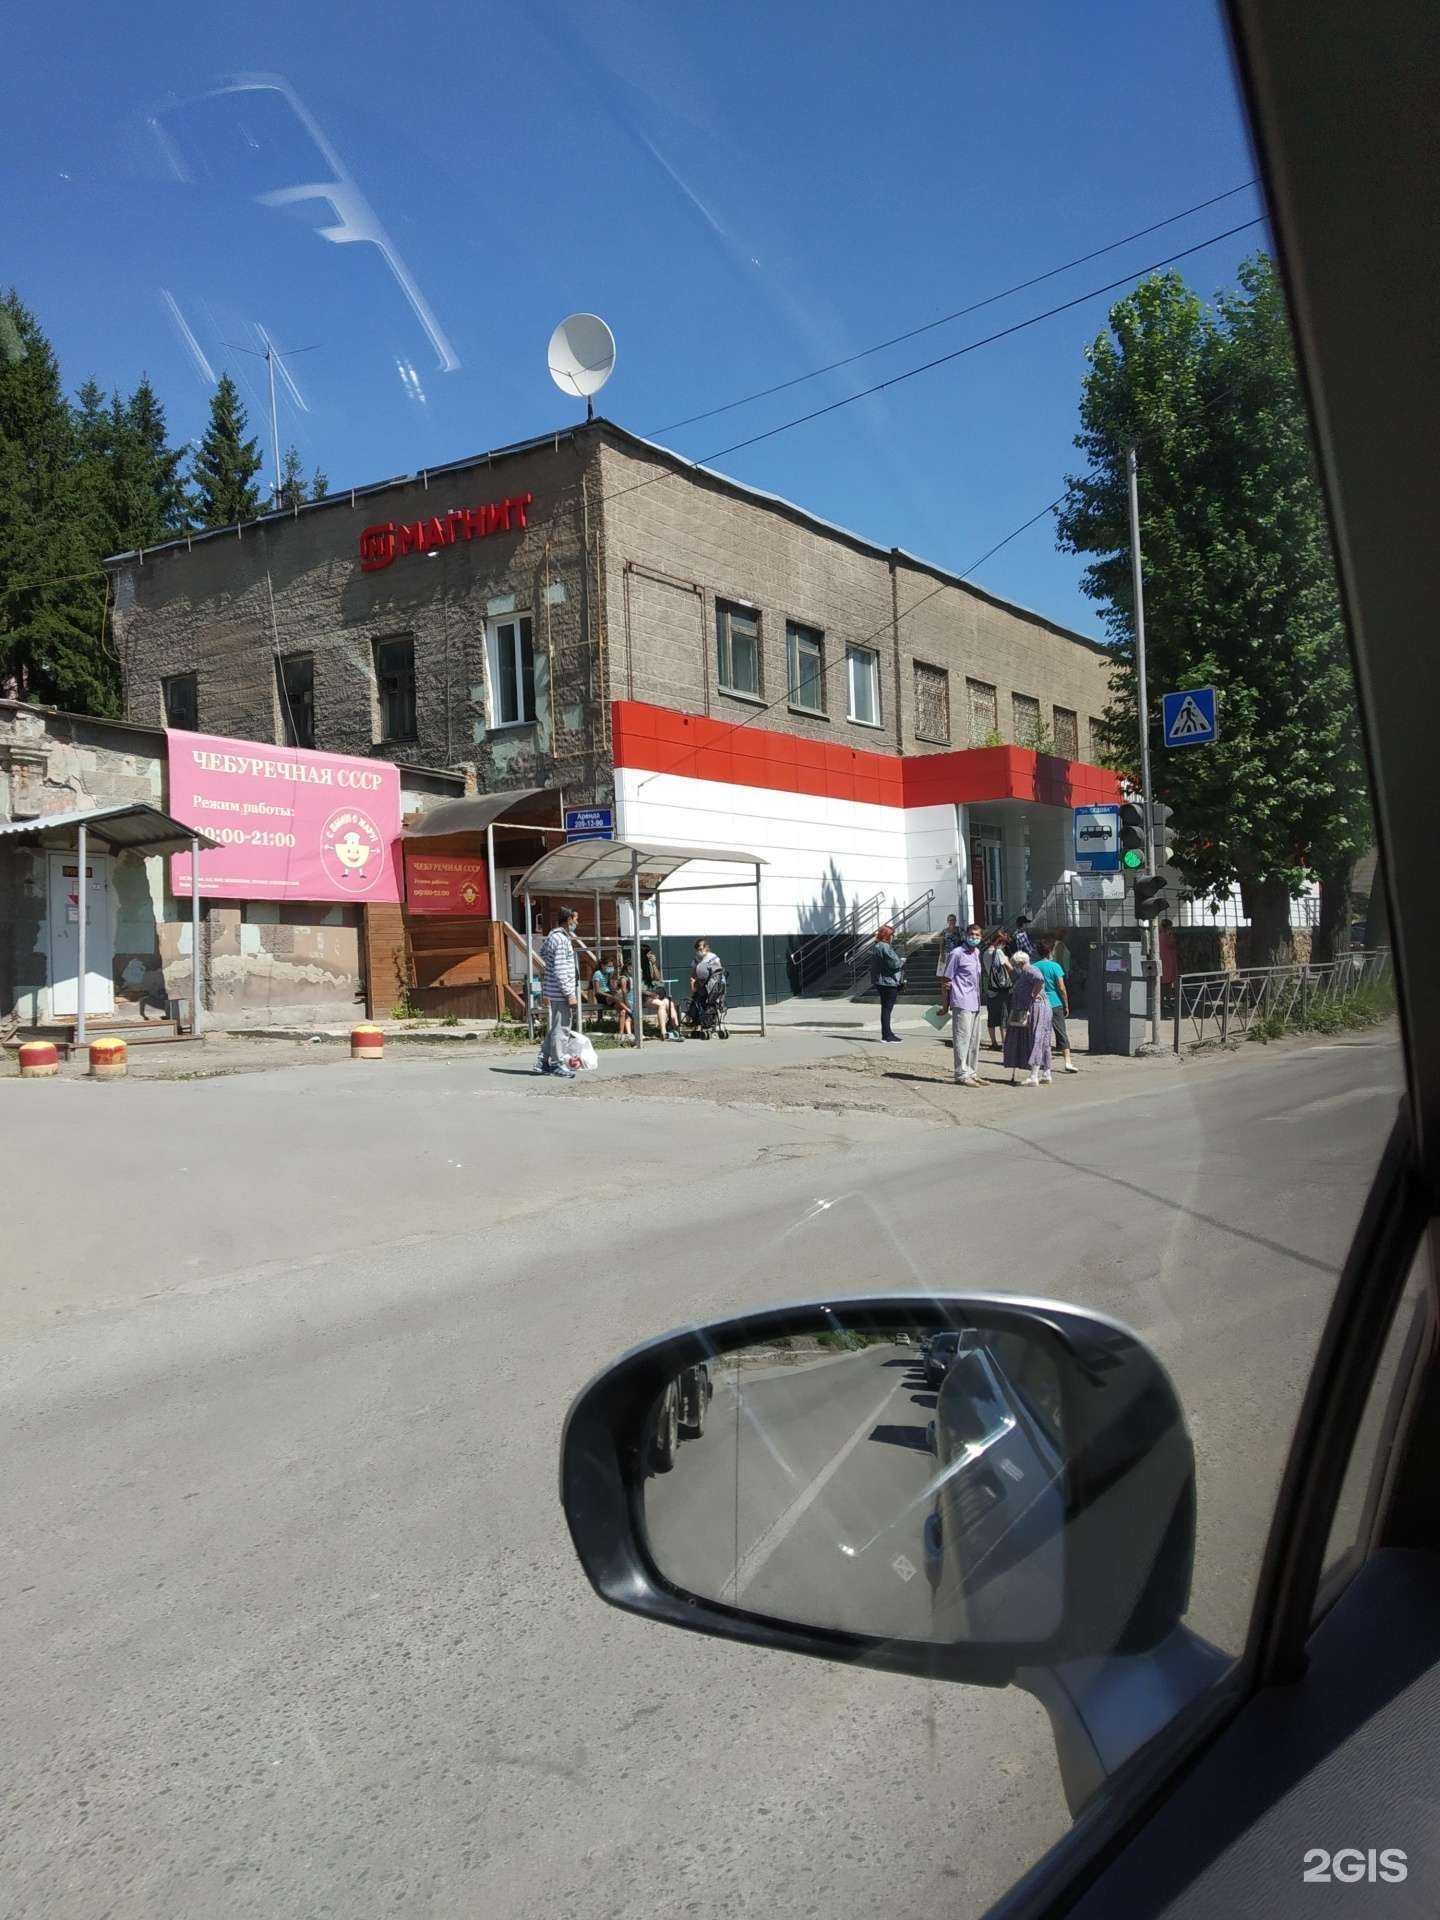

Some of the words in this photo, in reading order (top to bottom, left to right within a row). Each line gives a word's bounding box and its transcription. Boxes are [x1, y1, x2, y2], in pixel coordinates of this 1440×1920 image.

[400, 492, 533, 557] МАГНИТ
[192, 750, 334, 785] ЧЕБУРЕЧНАЯ
[337, 768, 382, 791] СССР
[192, 795, 240, 812] Режим
[242, 801, 295, 817] работы:
[577, 812, 600, 821] Аренда
